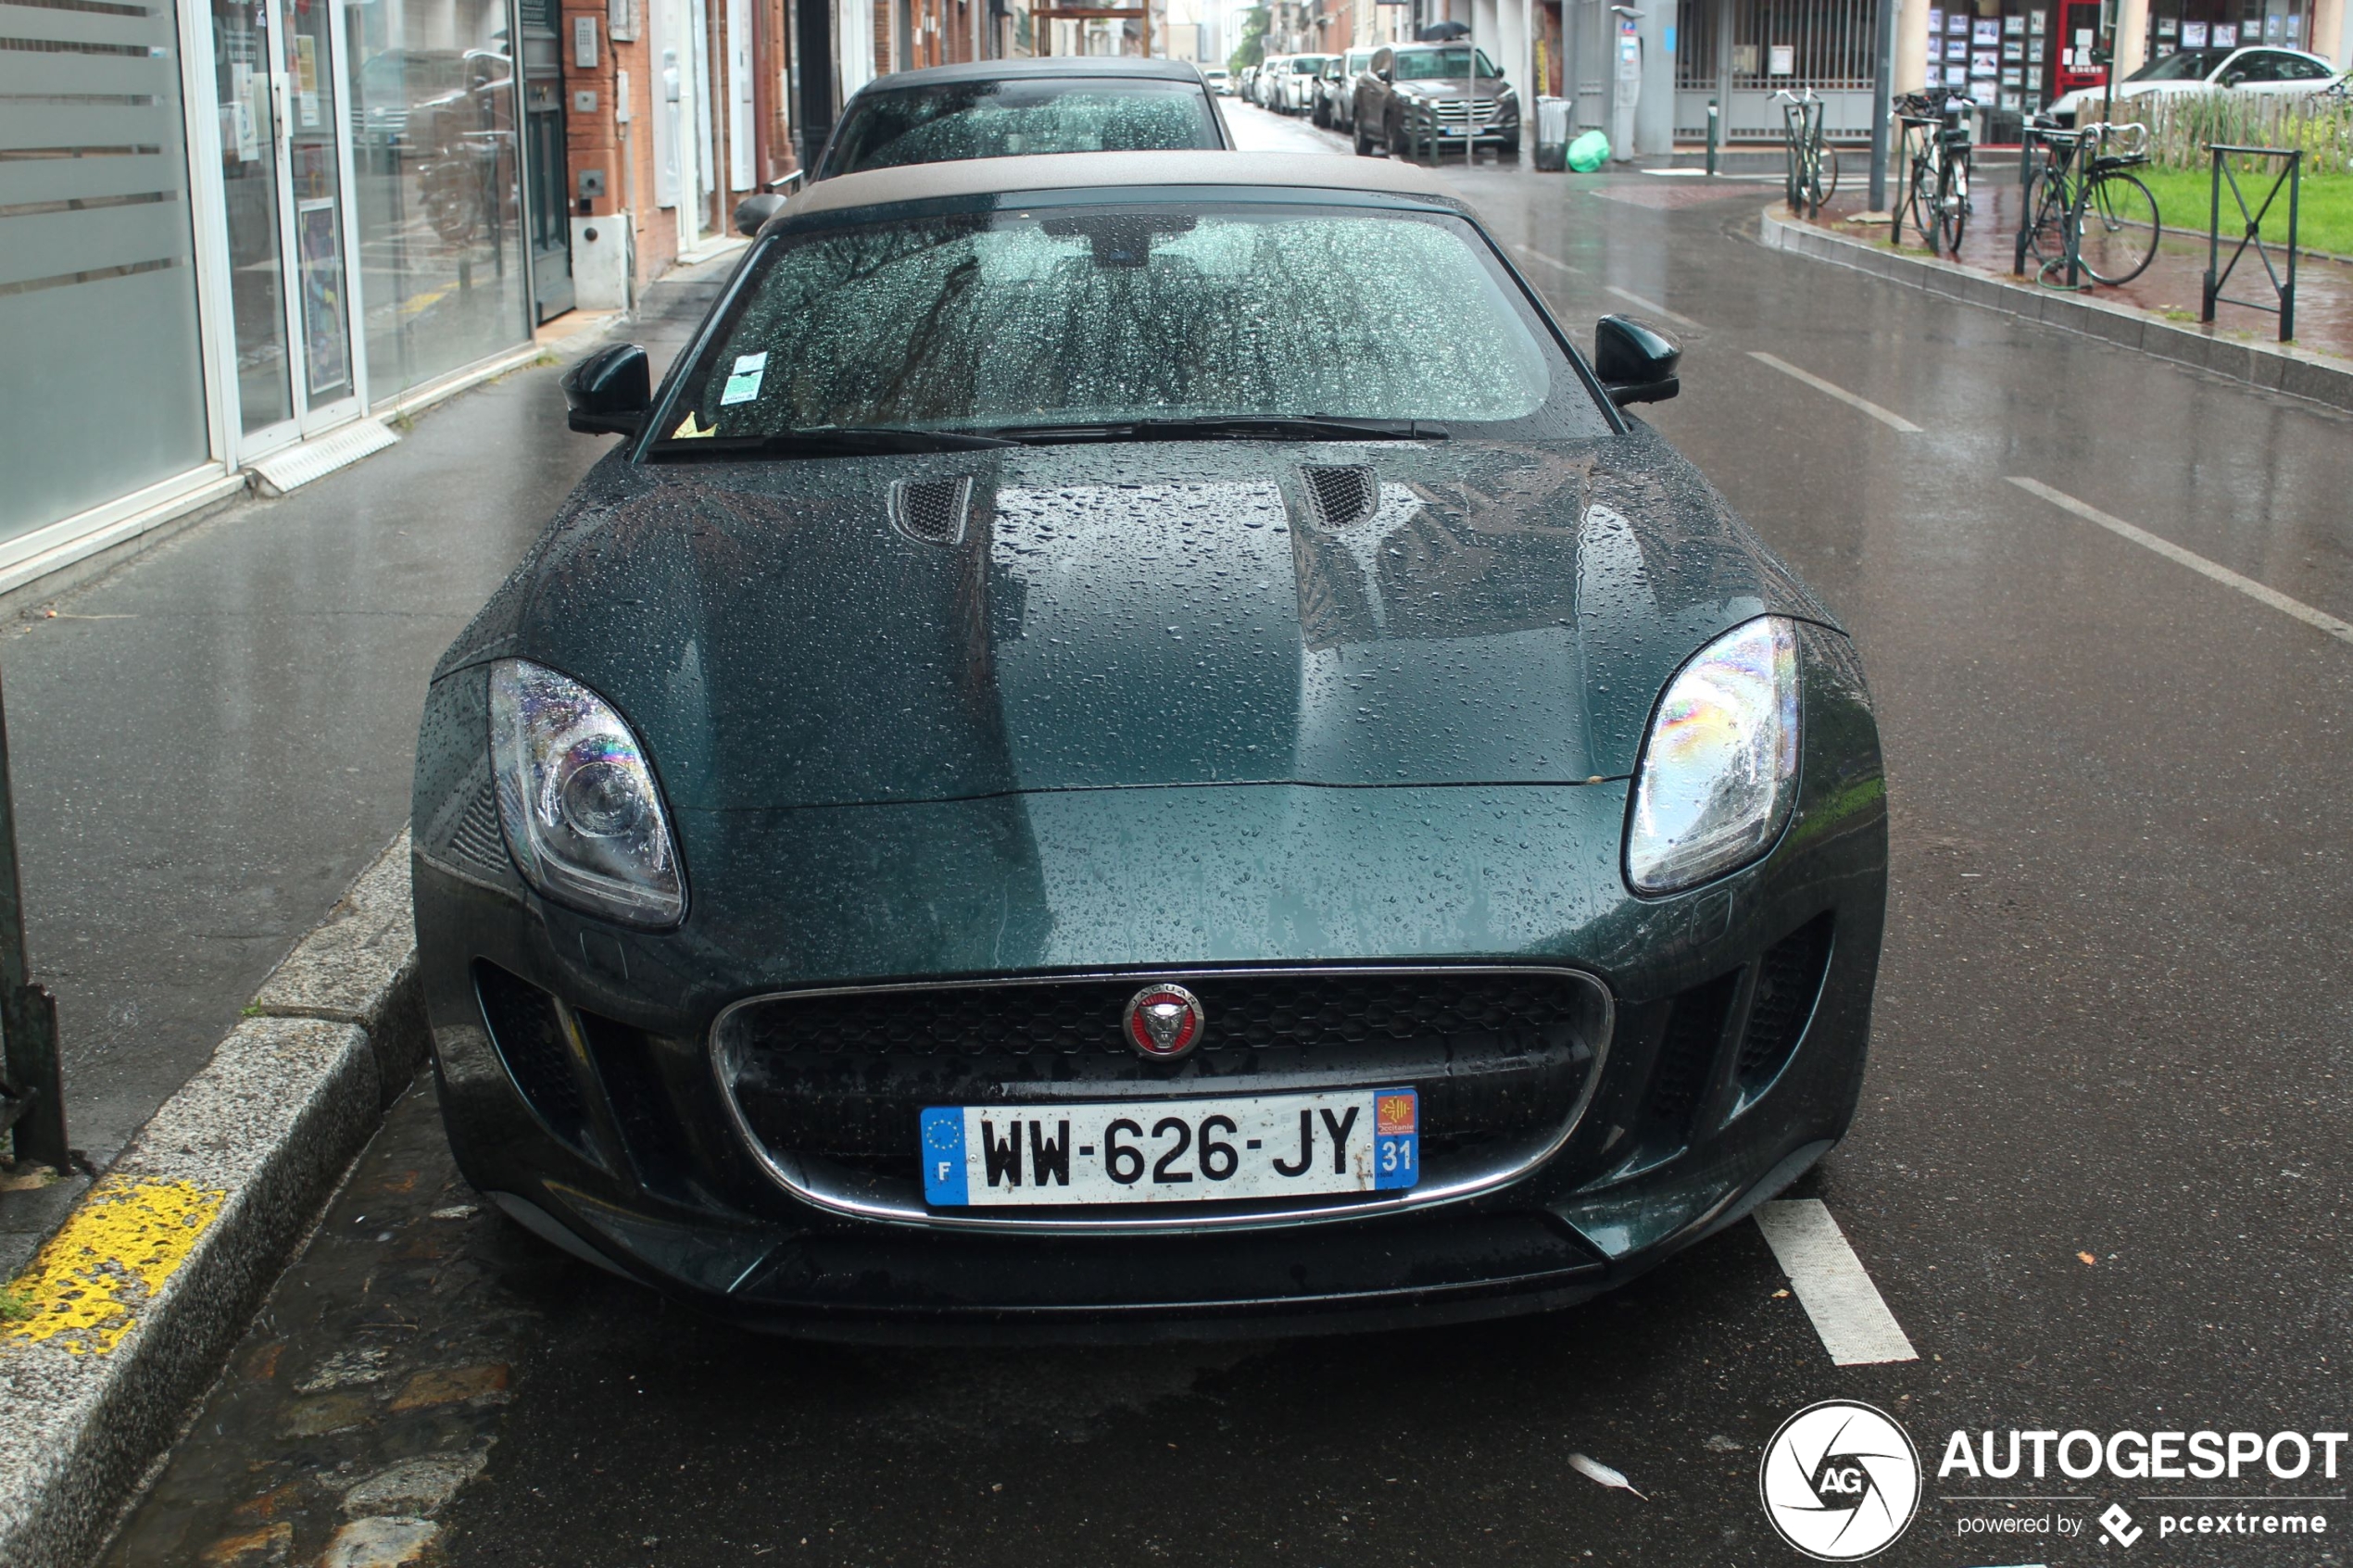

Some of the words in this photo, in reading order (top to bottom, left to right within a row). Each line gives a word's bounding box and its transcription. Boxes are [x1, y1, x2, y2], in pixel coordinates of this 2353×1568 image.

[1132, 985, 1198, 1008] JAGUAR
[981, 1106, 1360, 1187] WW-626-JY
[1382, 1139, 1411, 1172] 31
[938, 1161, 951, 1181] F
